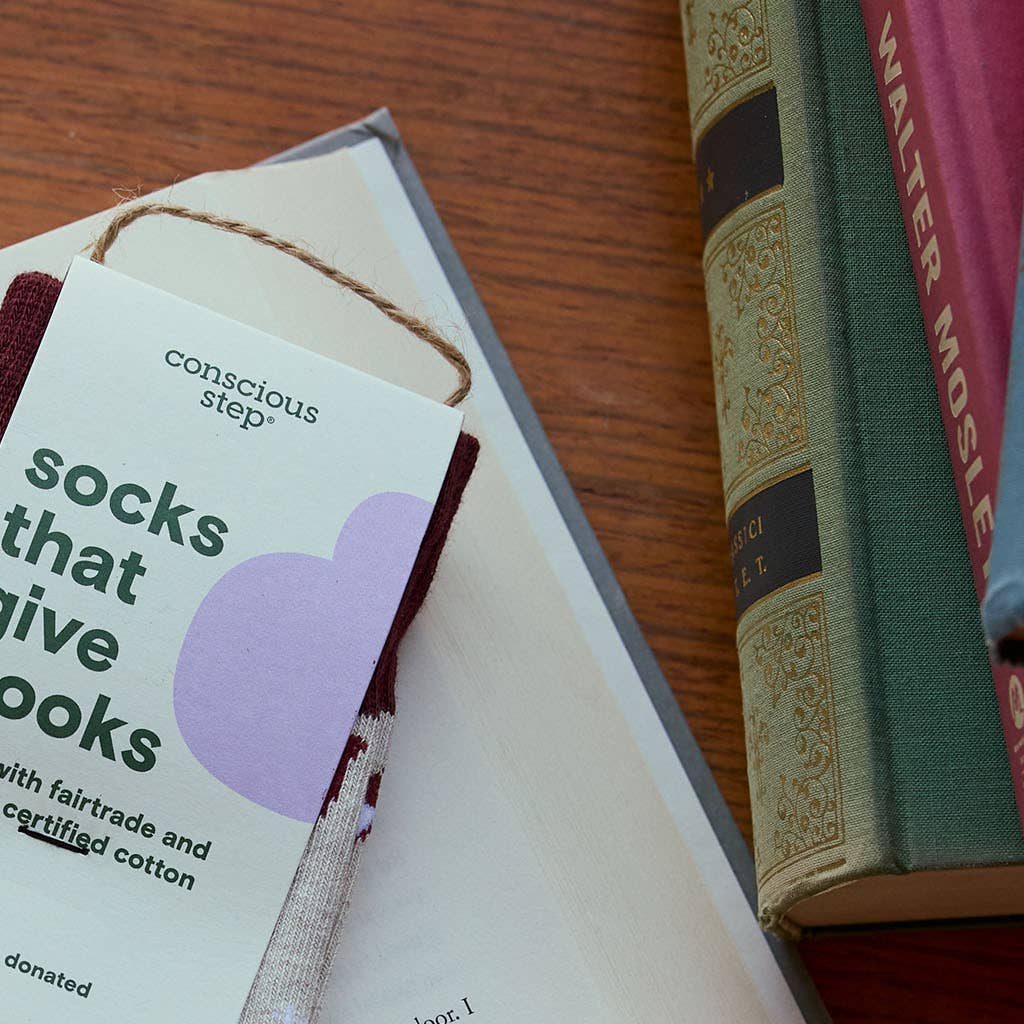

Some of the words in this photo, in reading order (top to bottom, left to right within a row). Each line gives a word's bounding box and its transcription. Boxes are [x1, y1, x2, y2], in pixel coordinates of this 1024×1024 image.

[878, 11, 941, 295] WALTER
[164, 349, 320, 424] conscious
[934, 304, 994, 579] MOSLE
[25, 446, 229, 557] socks
[0, 502, 148, 605] that
[3, 803, 110, 856] certified
[114, 848, 195, 891] cotton
[49, 779, 156, 838] fairtrade
[162, 831, 212, 861] and
[5, 953, 92, 998] donated
[461, 997, 474, 1015] I
